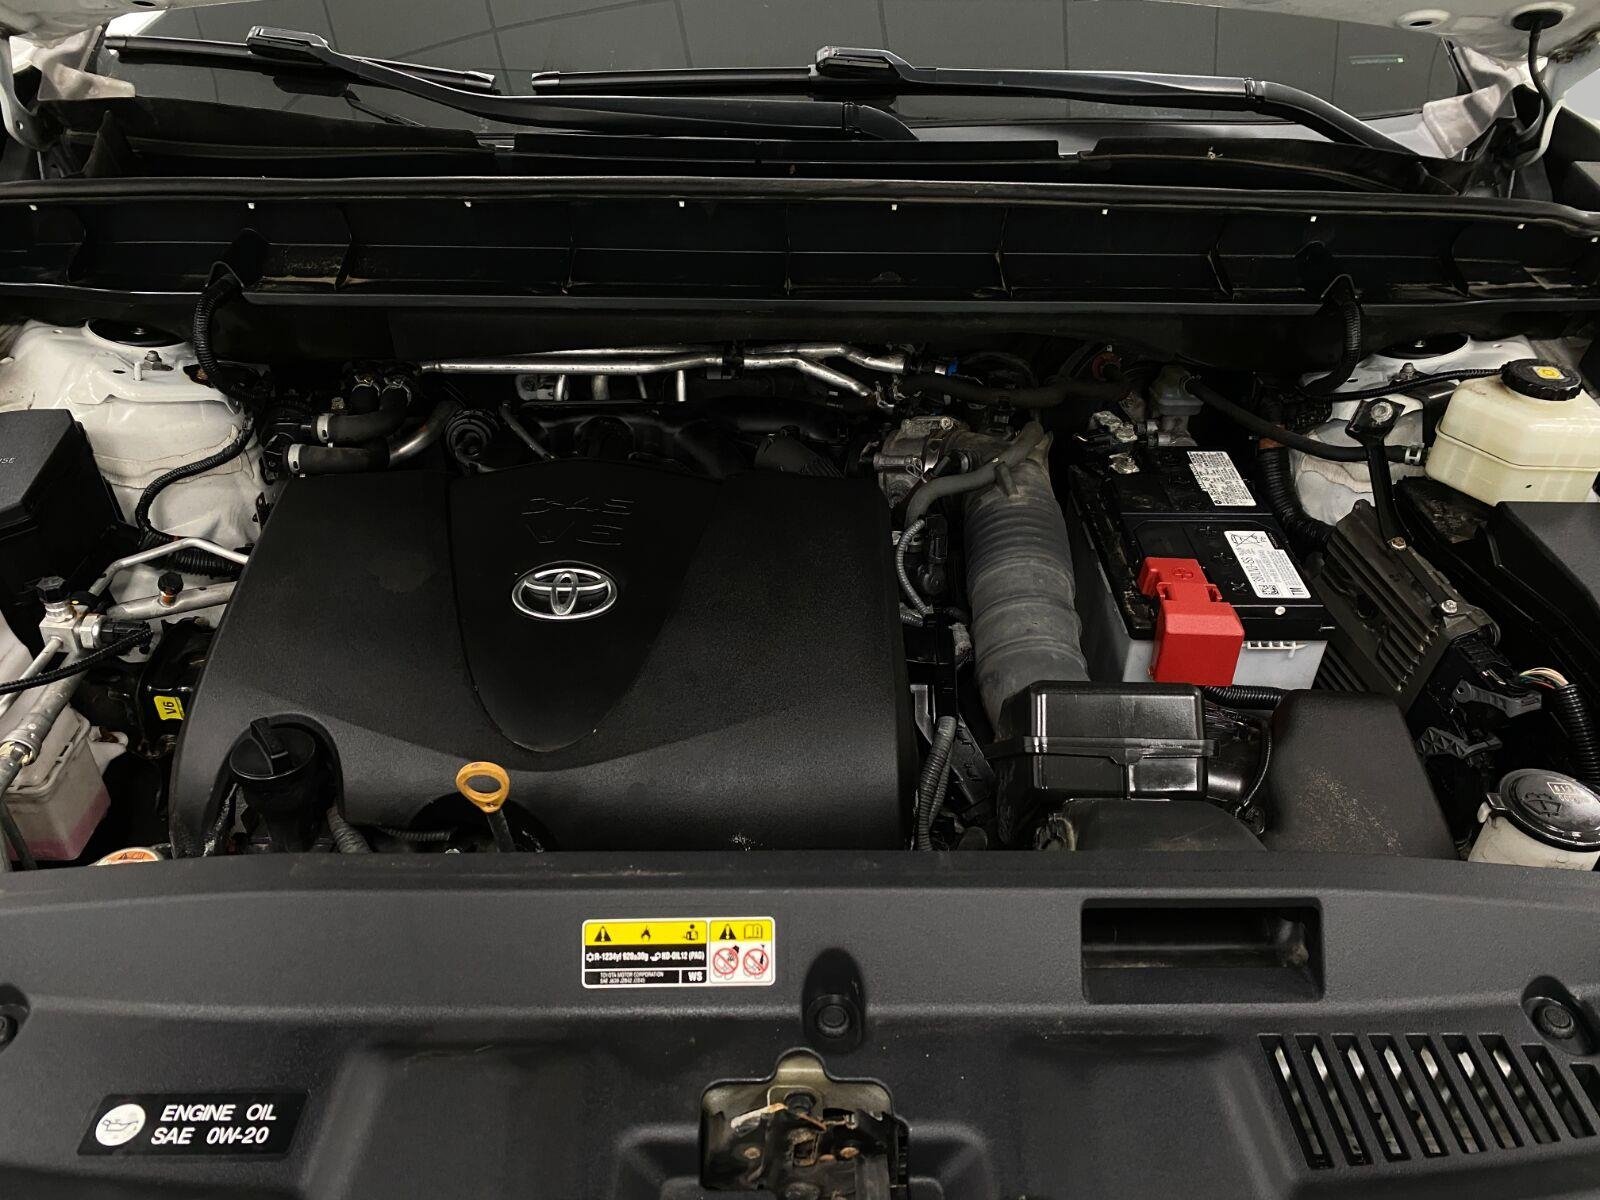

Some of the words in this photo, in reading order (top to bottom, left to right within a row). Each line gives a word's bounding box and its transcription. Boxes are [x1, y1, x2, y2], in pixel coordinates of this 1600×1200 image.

[163, 701, 177, 715] V6
[688, 971, 703, 982] WS
[160, 1104, 236, 1121] ENGINE
[246, 1103, 277, 1121] OIL
[150, 1127, 196, 1144] SAE
[206, 1126, 270, 1144] 0W-20
